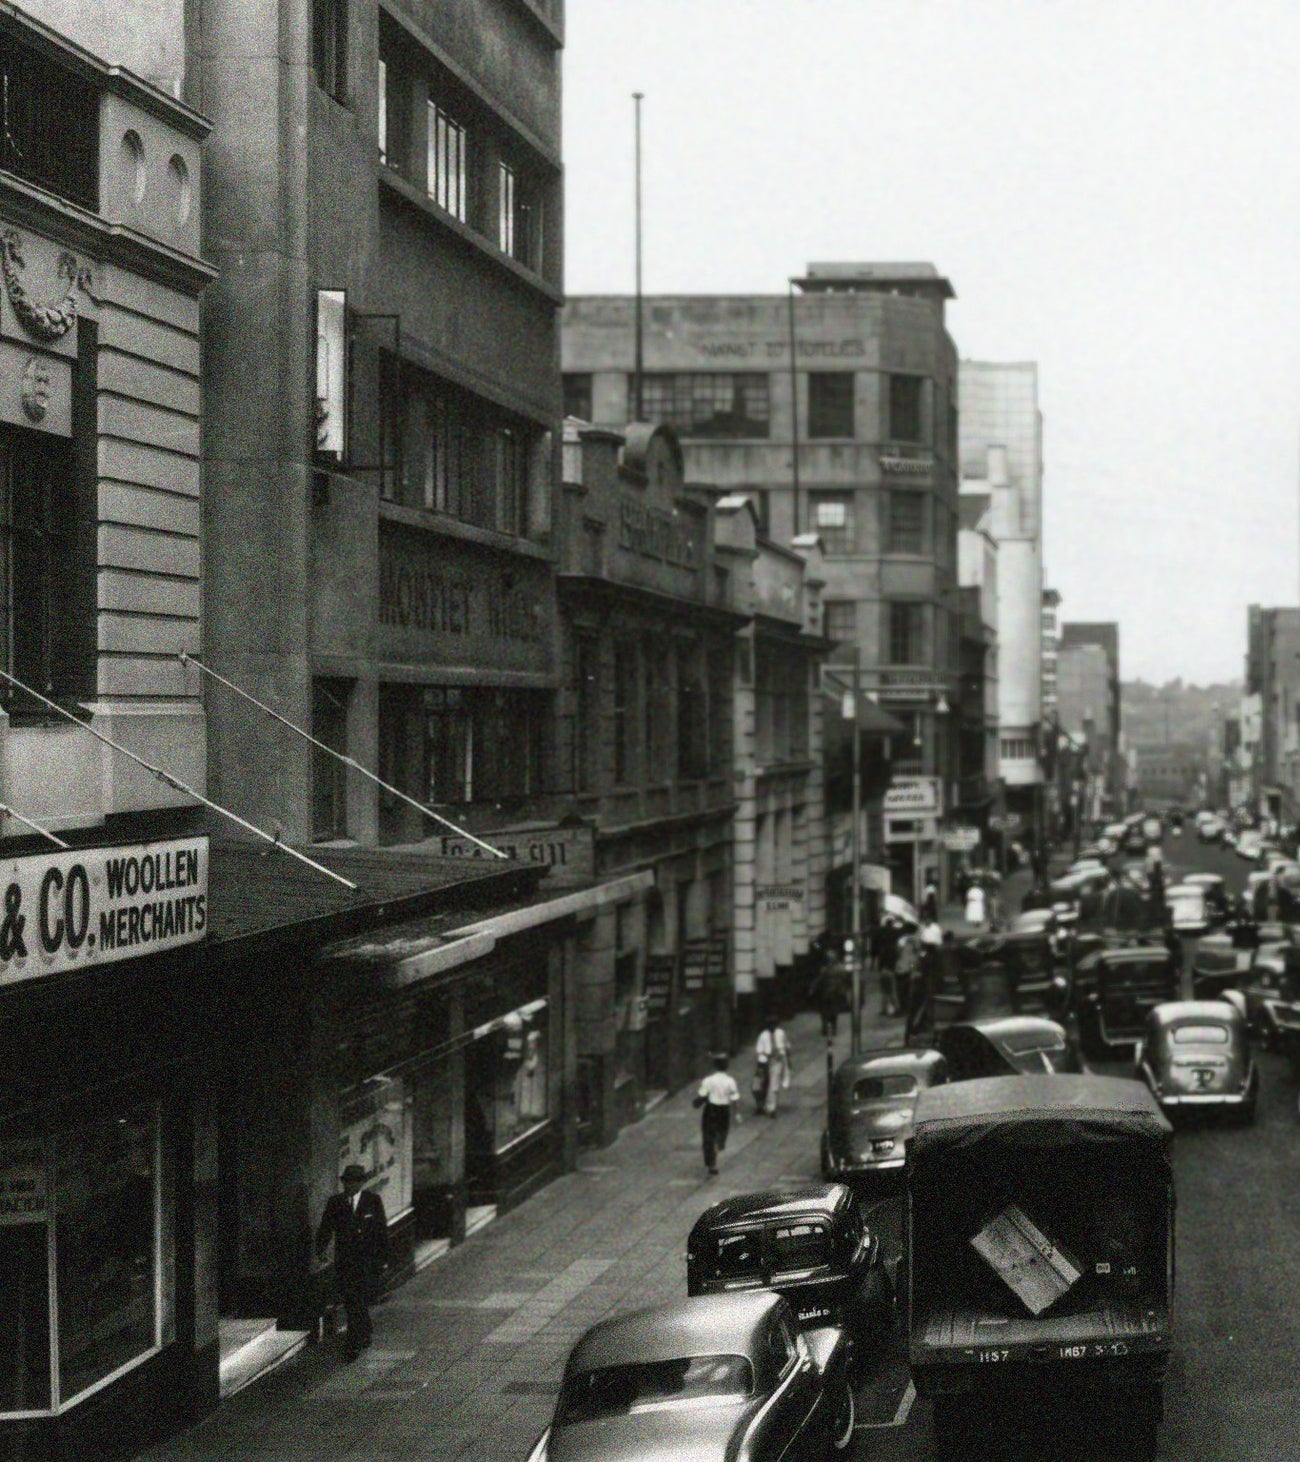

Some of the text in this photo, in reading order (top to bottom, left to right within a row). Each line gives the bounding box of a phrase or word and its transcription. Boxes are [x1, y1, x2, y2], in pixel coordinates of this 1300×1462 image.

[106, 849, 198, 899] WOOLLEN
[0, 864, 96, 961] & CO.
[100, 894, 206, 951] MERCHANTS
